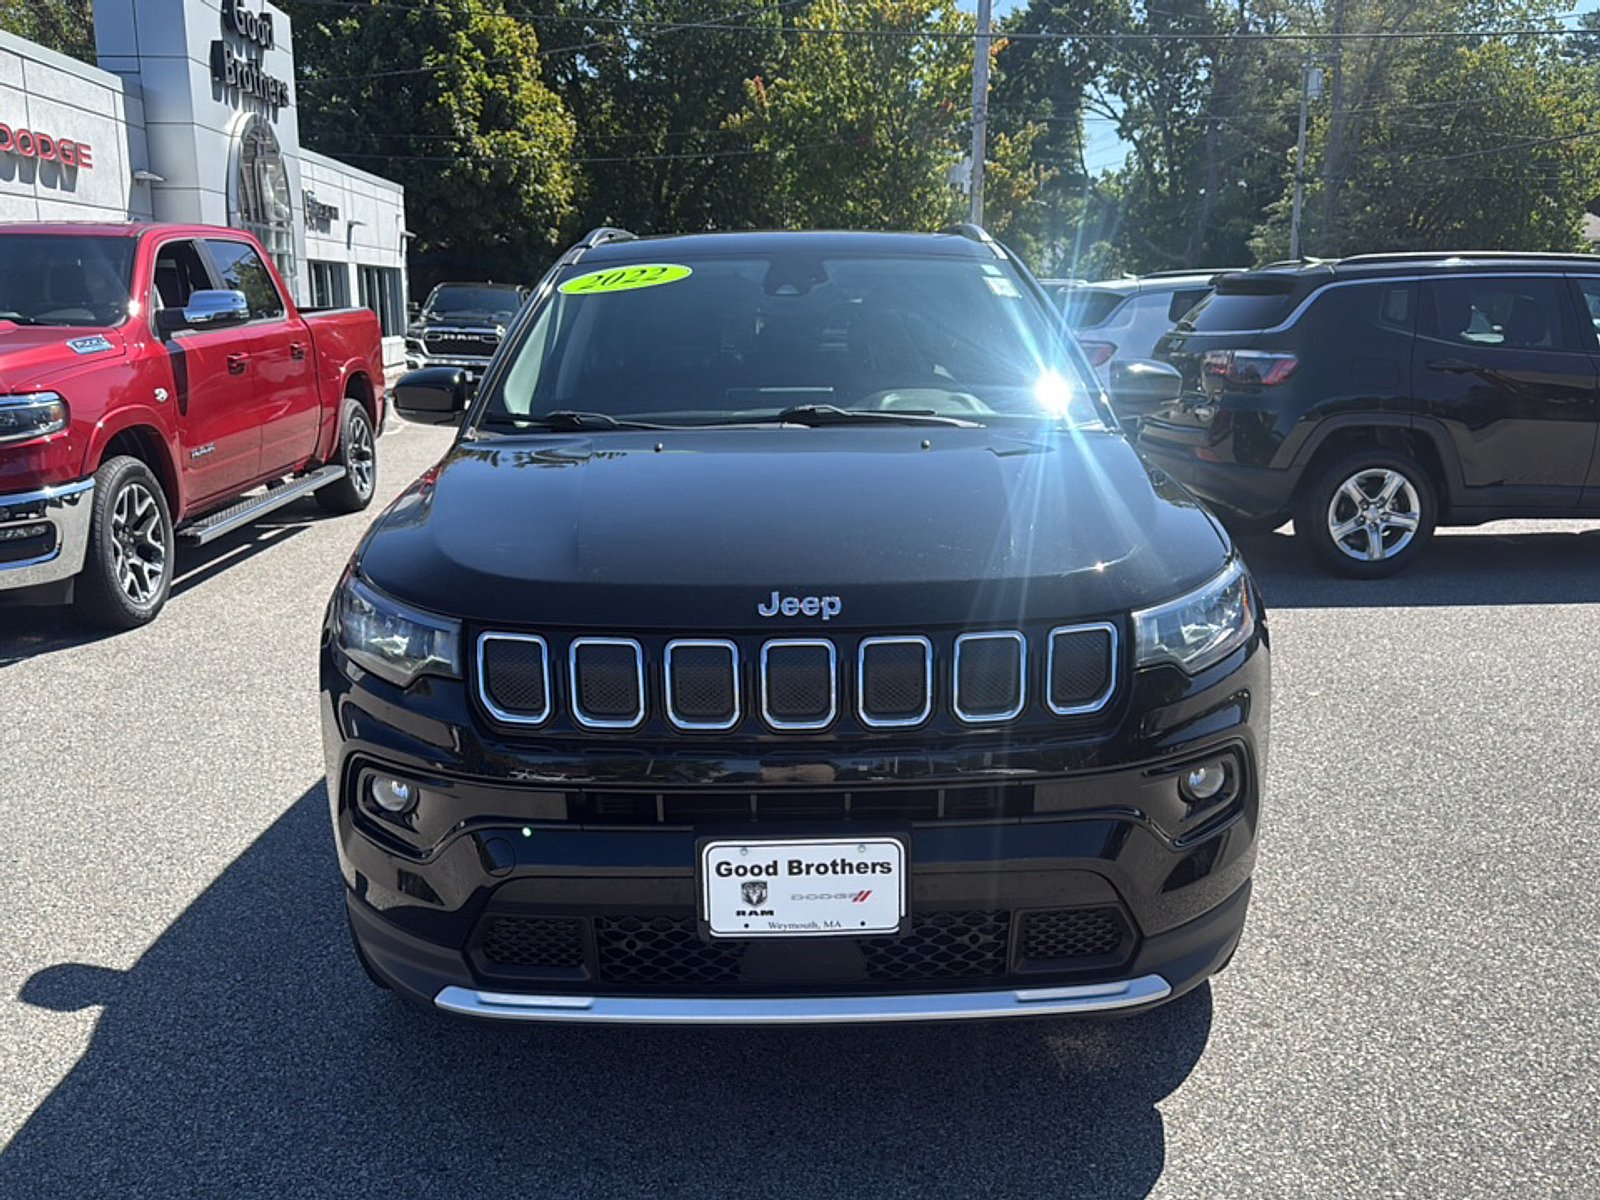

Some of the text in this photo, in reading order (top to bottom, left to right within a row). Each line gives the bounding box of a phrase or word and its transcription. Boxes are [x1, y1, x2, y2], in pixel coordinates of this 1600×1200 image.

[221, 0, 274, 50] Good
[211, 40, 289, 107] Brothers
[0, 123, 93, 169] DODGE
[577, 267, 668, 291] 2022
[758, 591, 842, 620] Jeep
[715, 859, 892, 877] Good Brothers
[768, 919, 842, 931] Weymouth, MA
